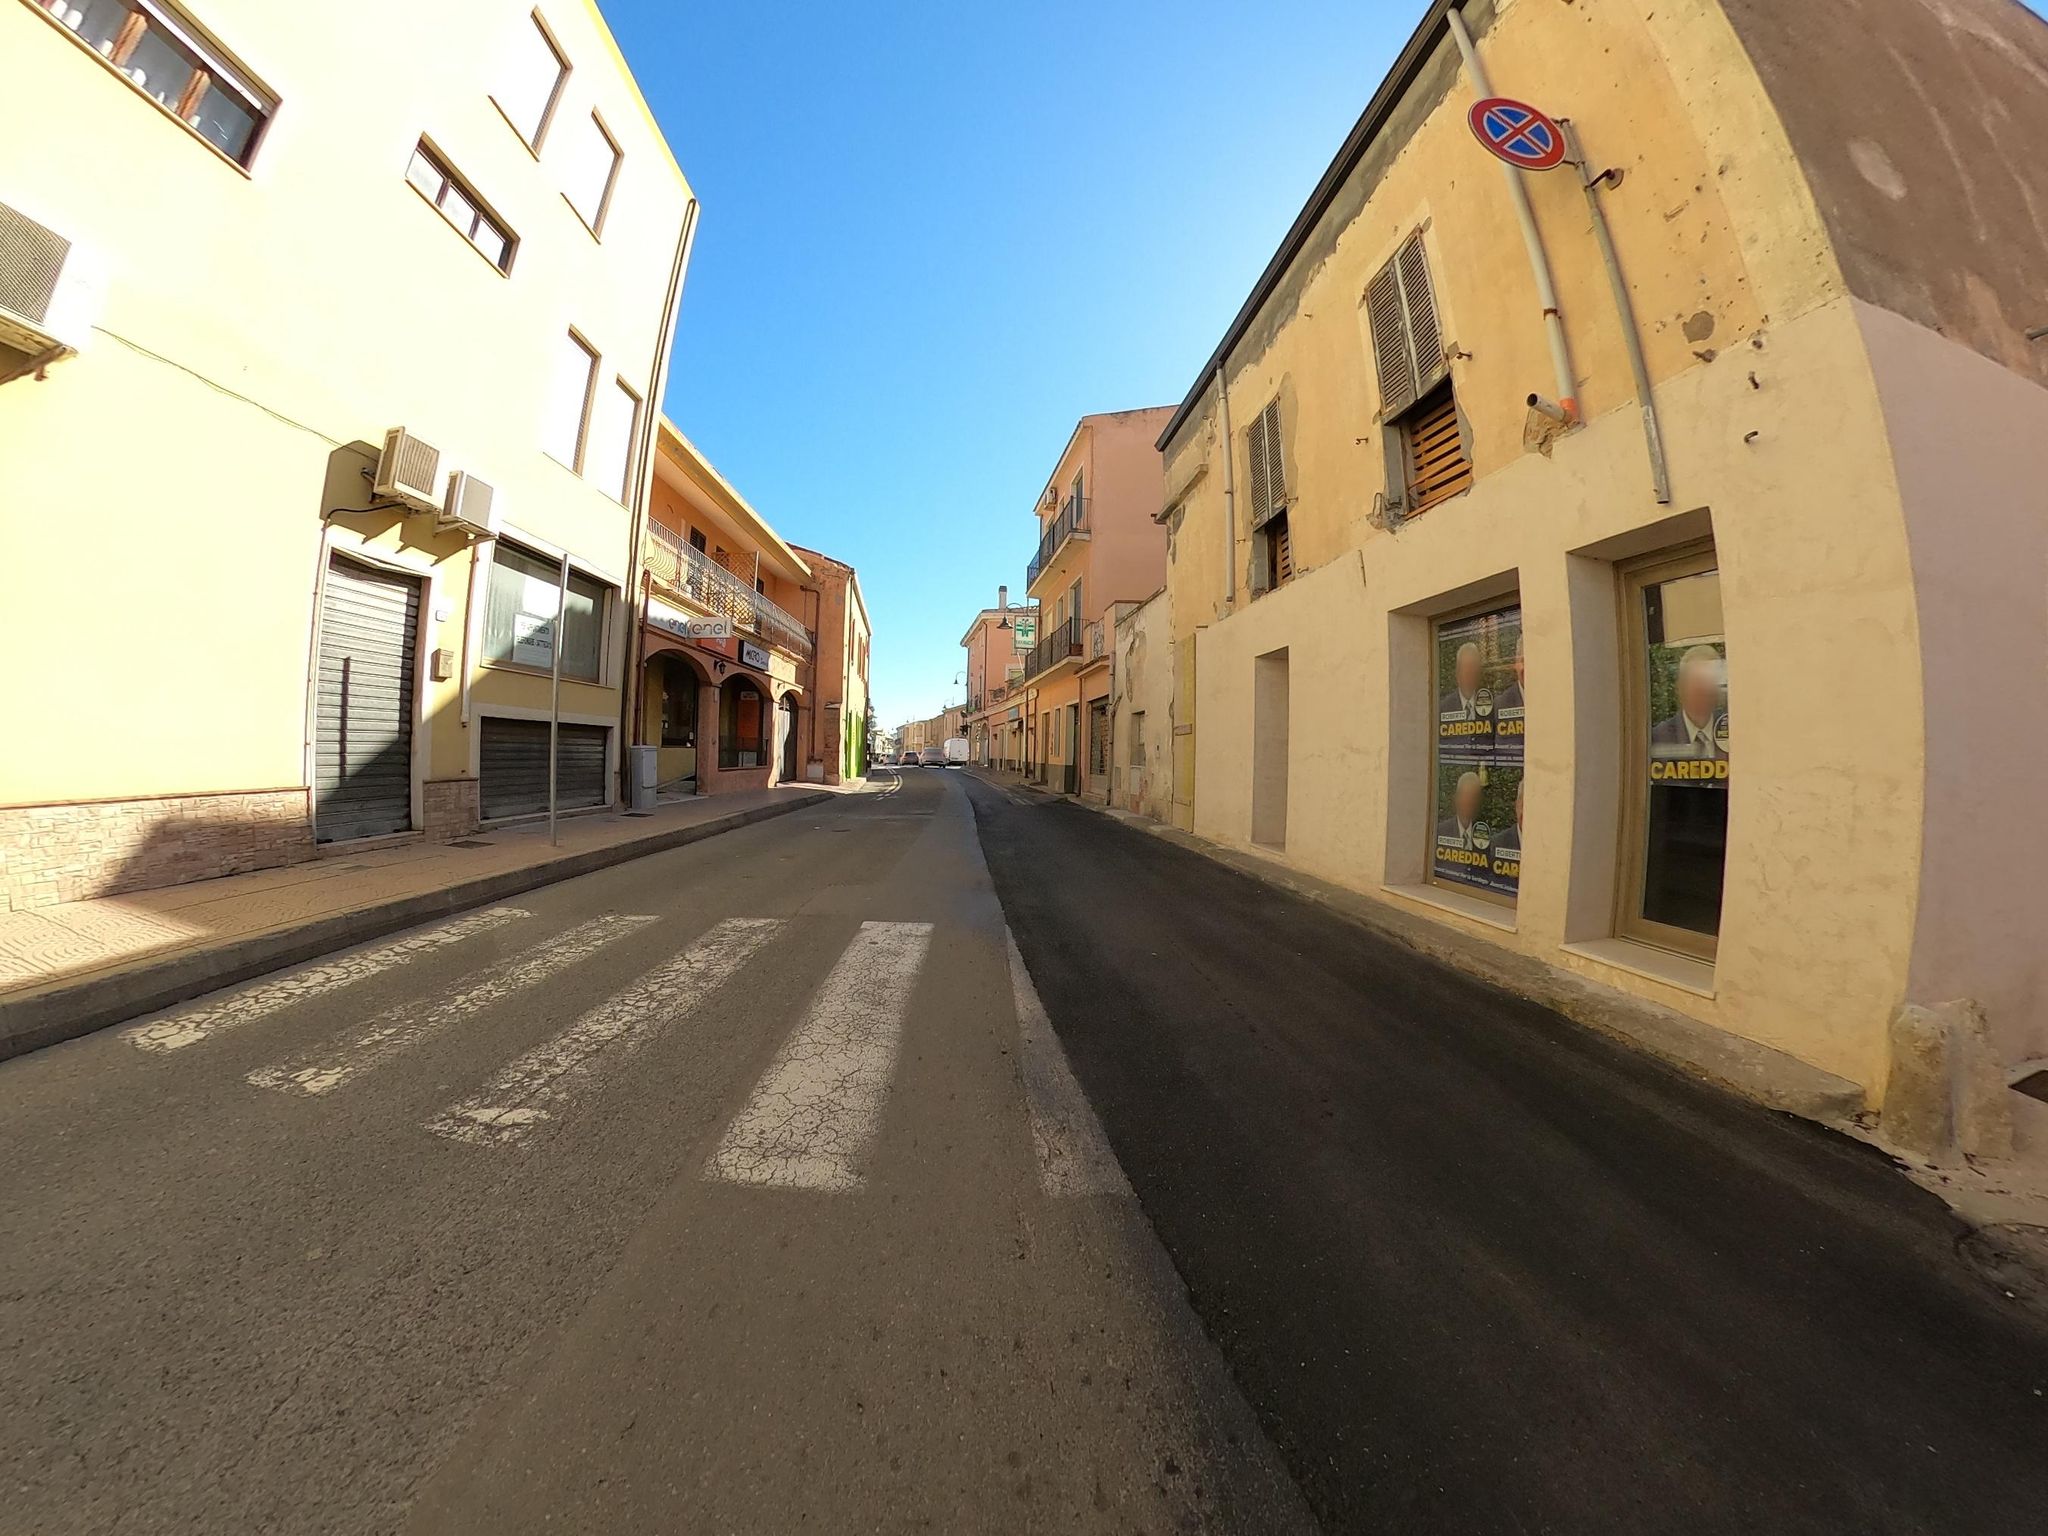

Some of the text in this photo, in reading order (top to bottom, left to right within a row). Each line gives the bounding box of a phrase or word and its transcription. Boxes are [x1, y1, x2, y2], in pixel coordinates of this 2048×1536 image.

[692, 621, 727, 635] enel
[1500, 709, 1524, 717] ROBERT
[1440, 720, 1492, 736] CAREDDA
[1497, 720, 1524, 736] CAR
[1651, 760, 1729, 780] CAREDD
[1436, 847, 1488, 868] CAREDDA
[1493, 860, 1520, 876] CAR
